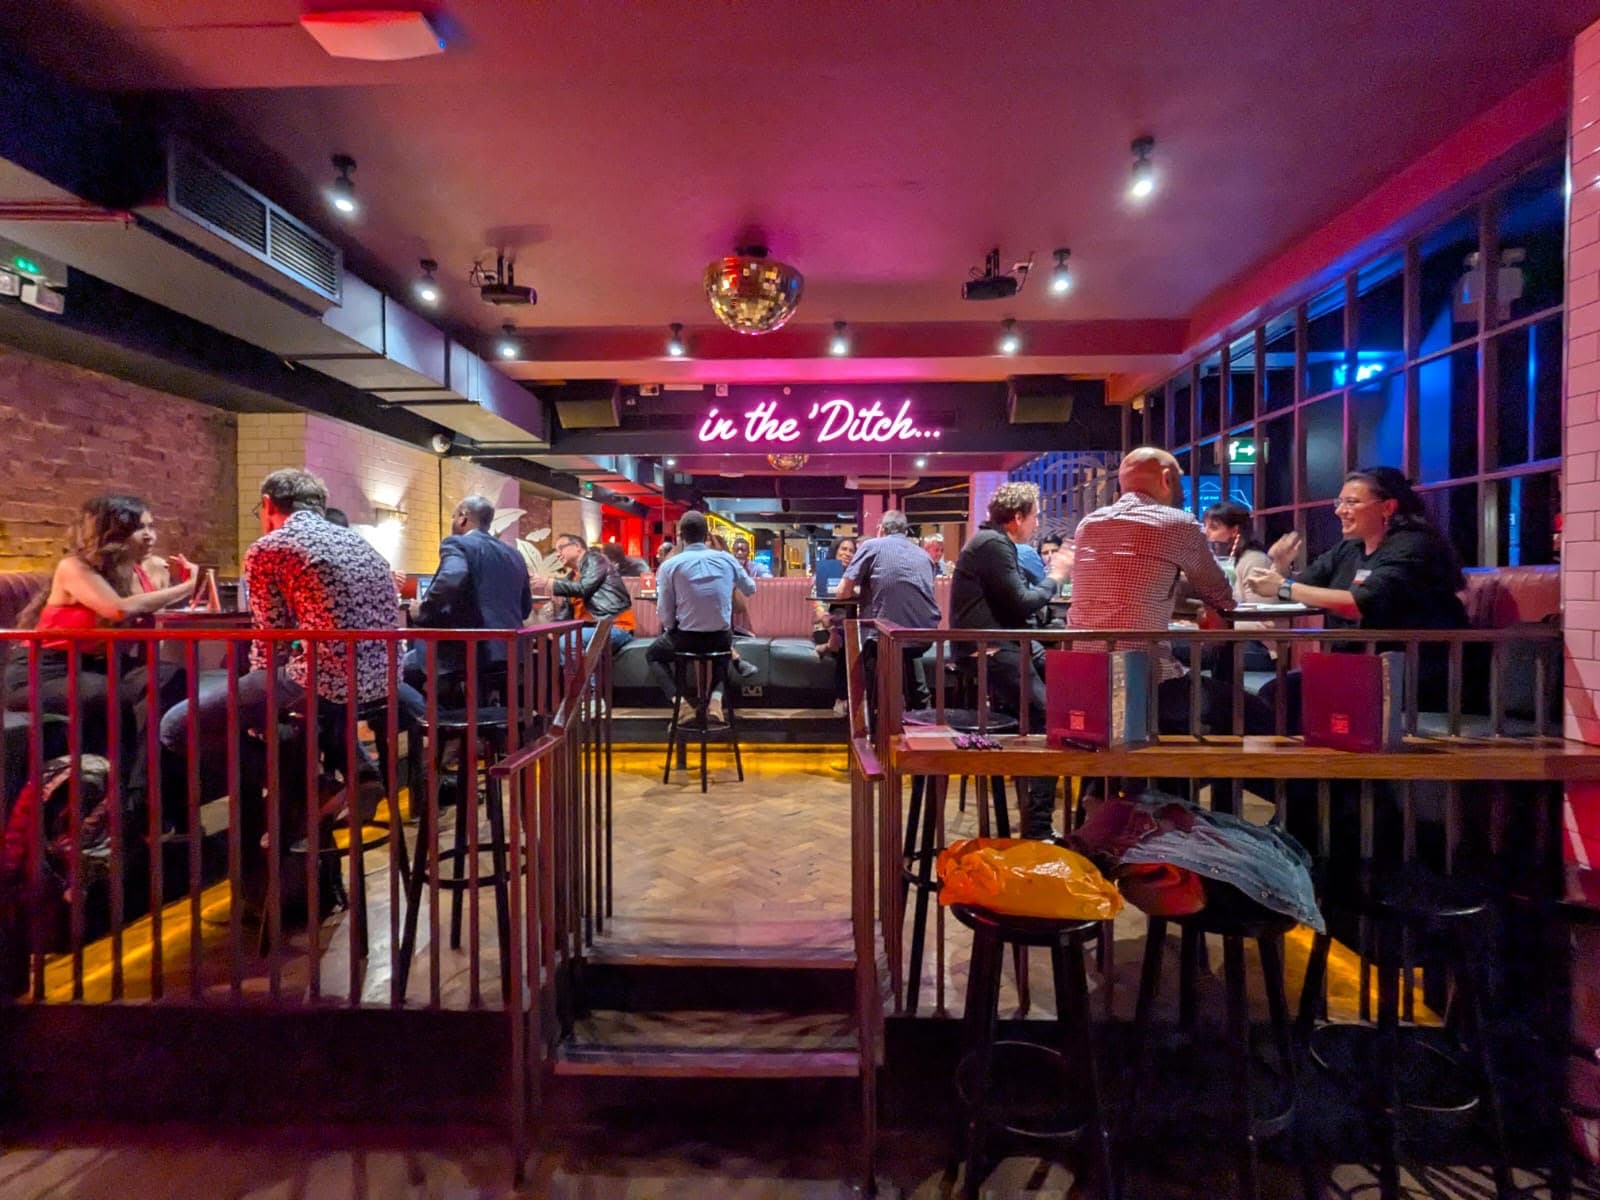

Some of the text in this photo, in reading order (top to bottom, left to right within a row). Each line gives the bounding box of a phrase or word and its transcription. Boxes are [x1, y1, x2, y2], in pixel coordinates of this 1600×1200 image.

[698, 399, 941, 442] in the 'Ditch...
